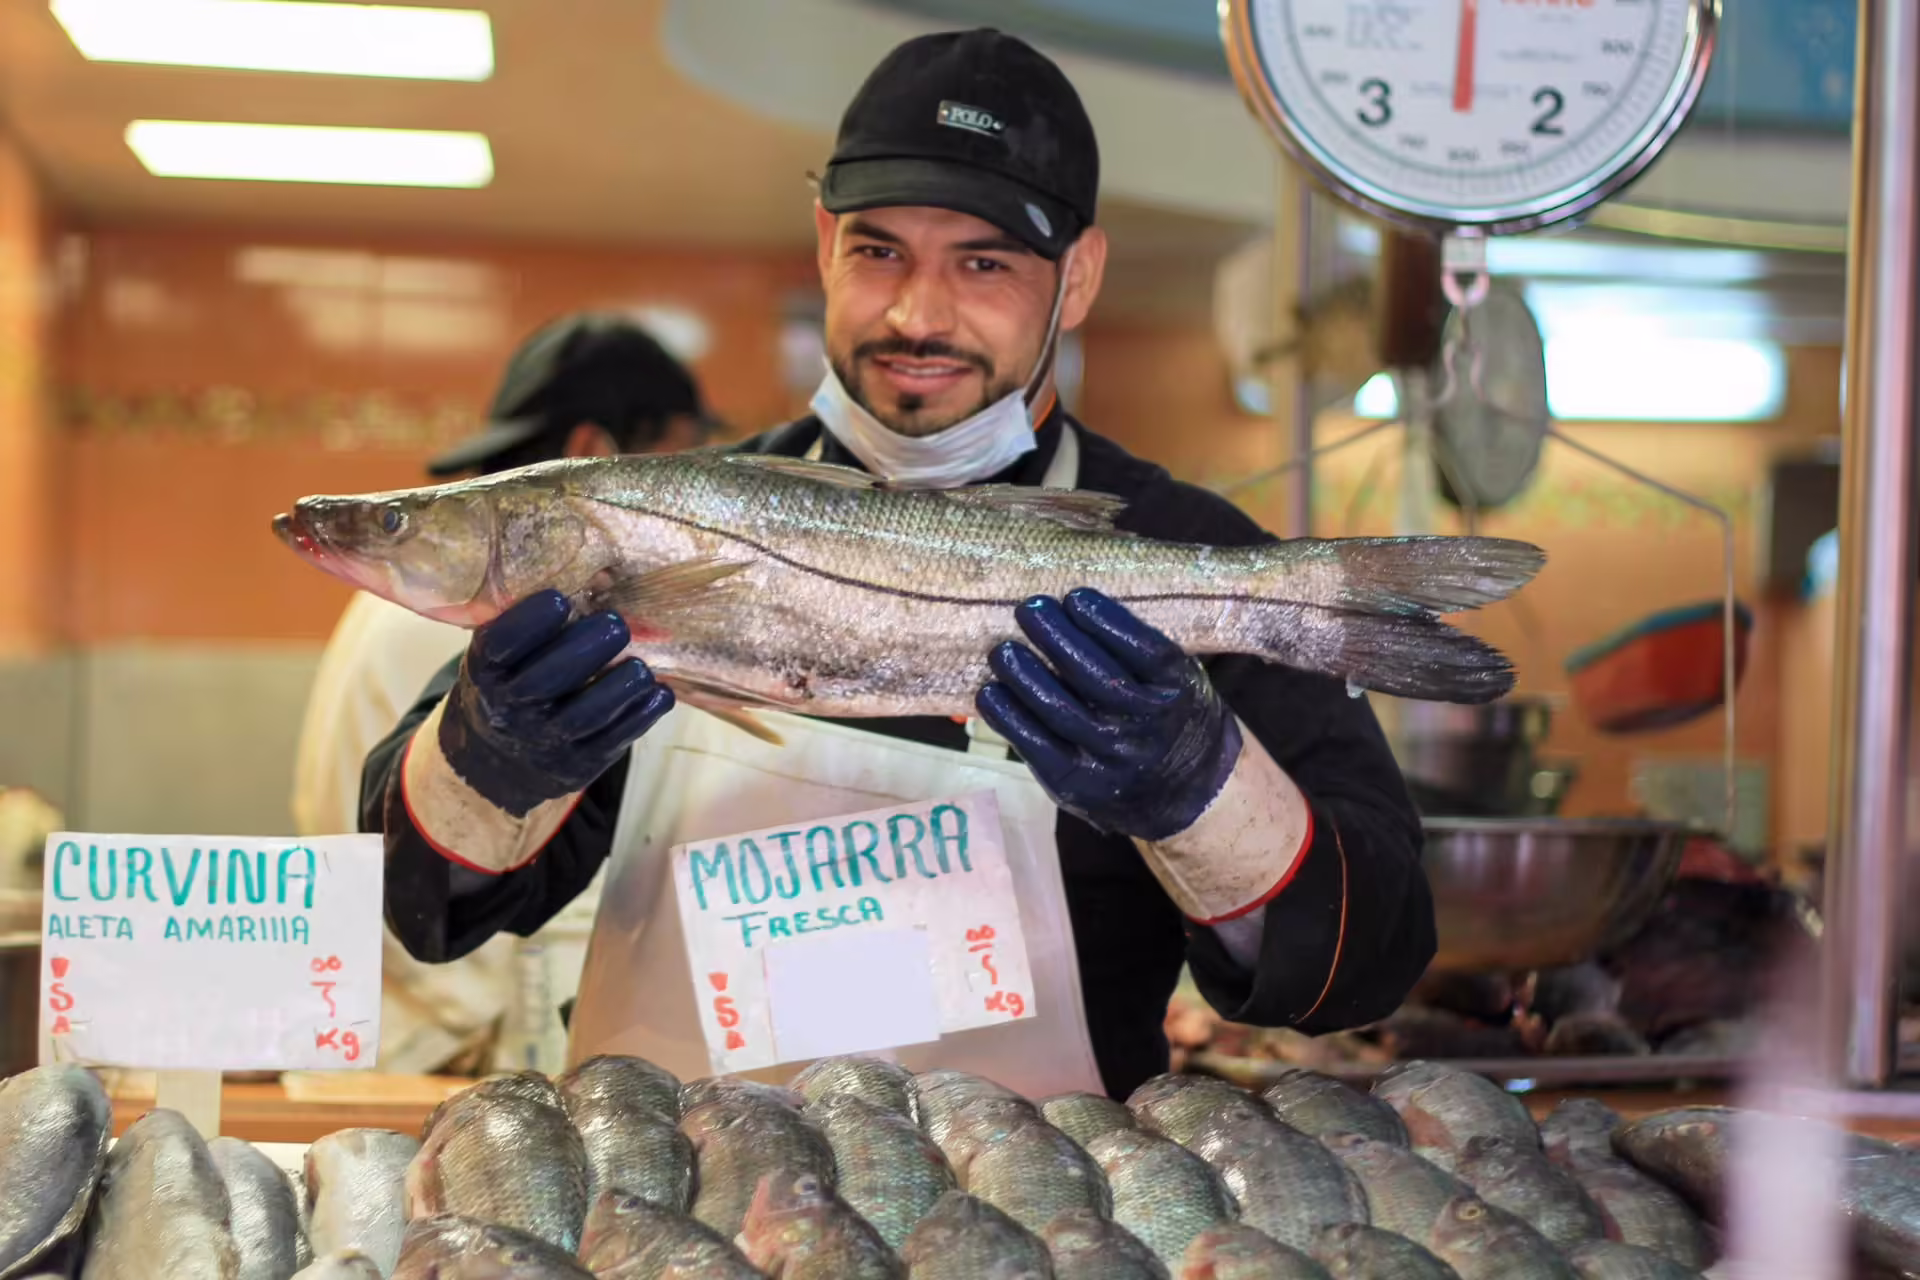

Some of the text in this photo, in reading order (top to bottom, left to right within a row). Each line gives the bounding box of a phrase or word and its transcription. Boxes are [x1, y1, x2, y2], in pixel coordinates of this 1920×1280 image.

[951, 106, 993, 128] POLO
[1357, 78, 1393, 127] 3
[1529, 85, 1566, 136] 2
[53, 841, 316, 909] CURVINA
[689, 804, 973, 910] MOJARRA
[49, 914, 134, 941] ALETA
[721, 896, 885, 948] FRESCA
